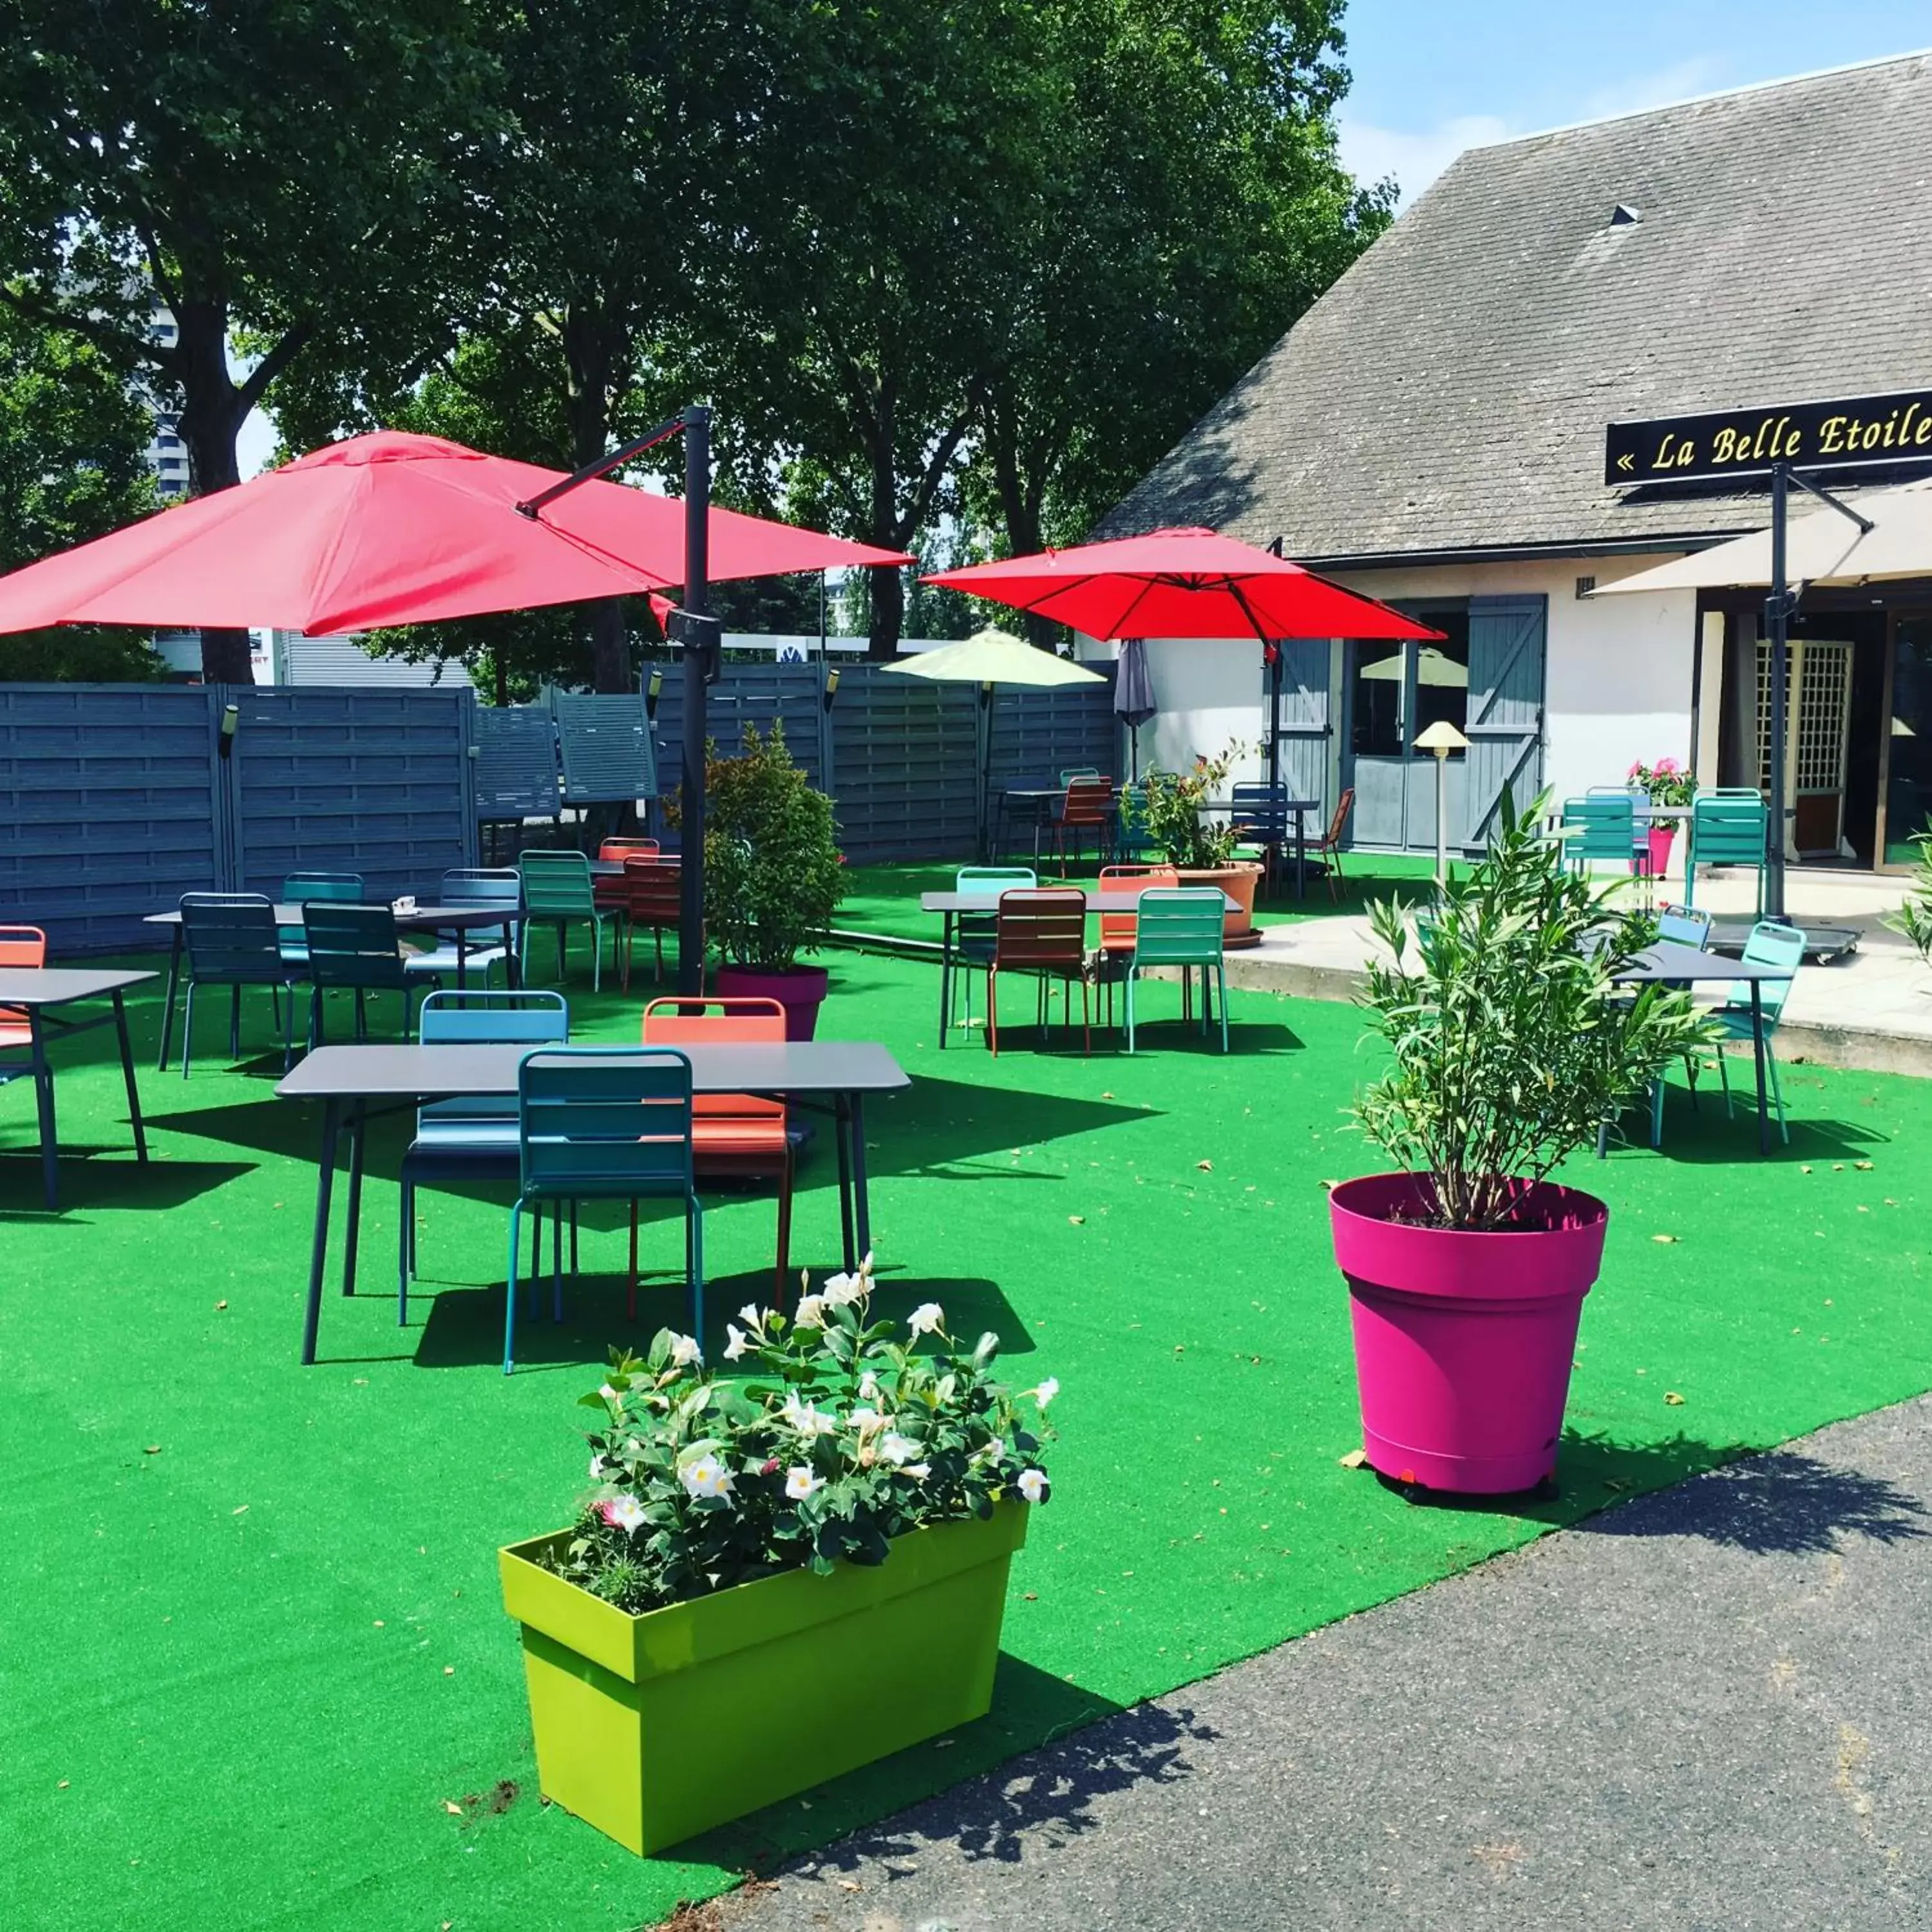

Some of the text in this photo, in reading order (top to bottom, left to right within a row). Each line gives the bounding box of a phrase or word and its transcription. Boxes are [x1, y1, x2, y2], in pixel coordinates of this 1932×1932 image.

[1652, 434, 1694, 468] La
[1711, 417, 1801, 463] Belle
[1819, 402, 1932, 453] Etoile
